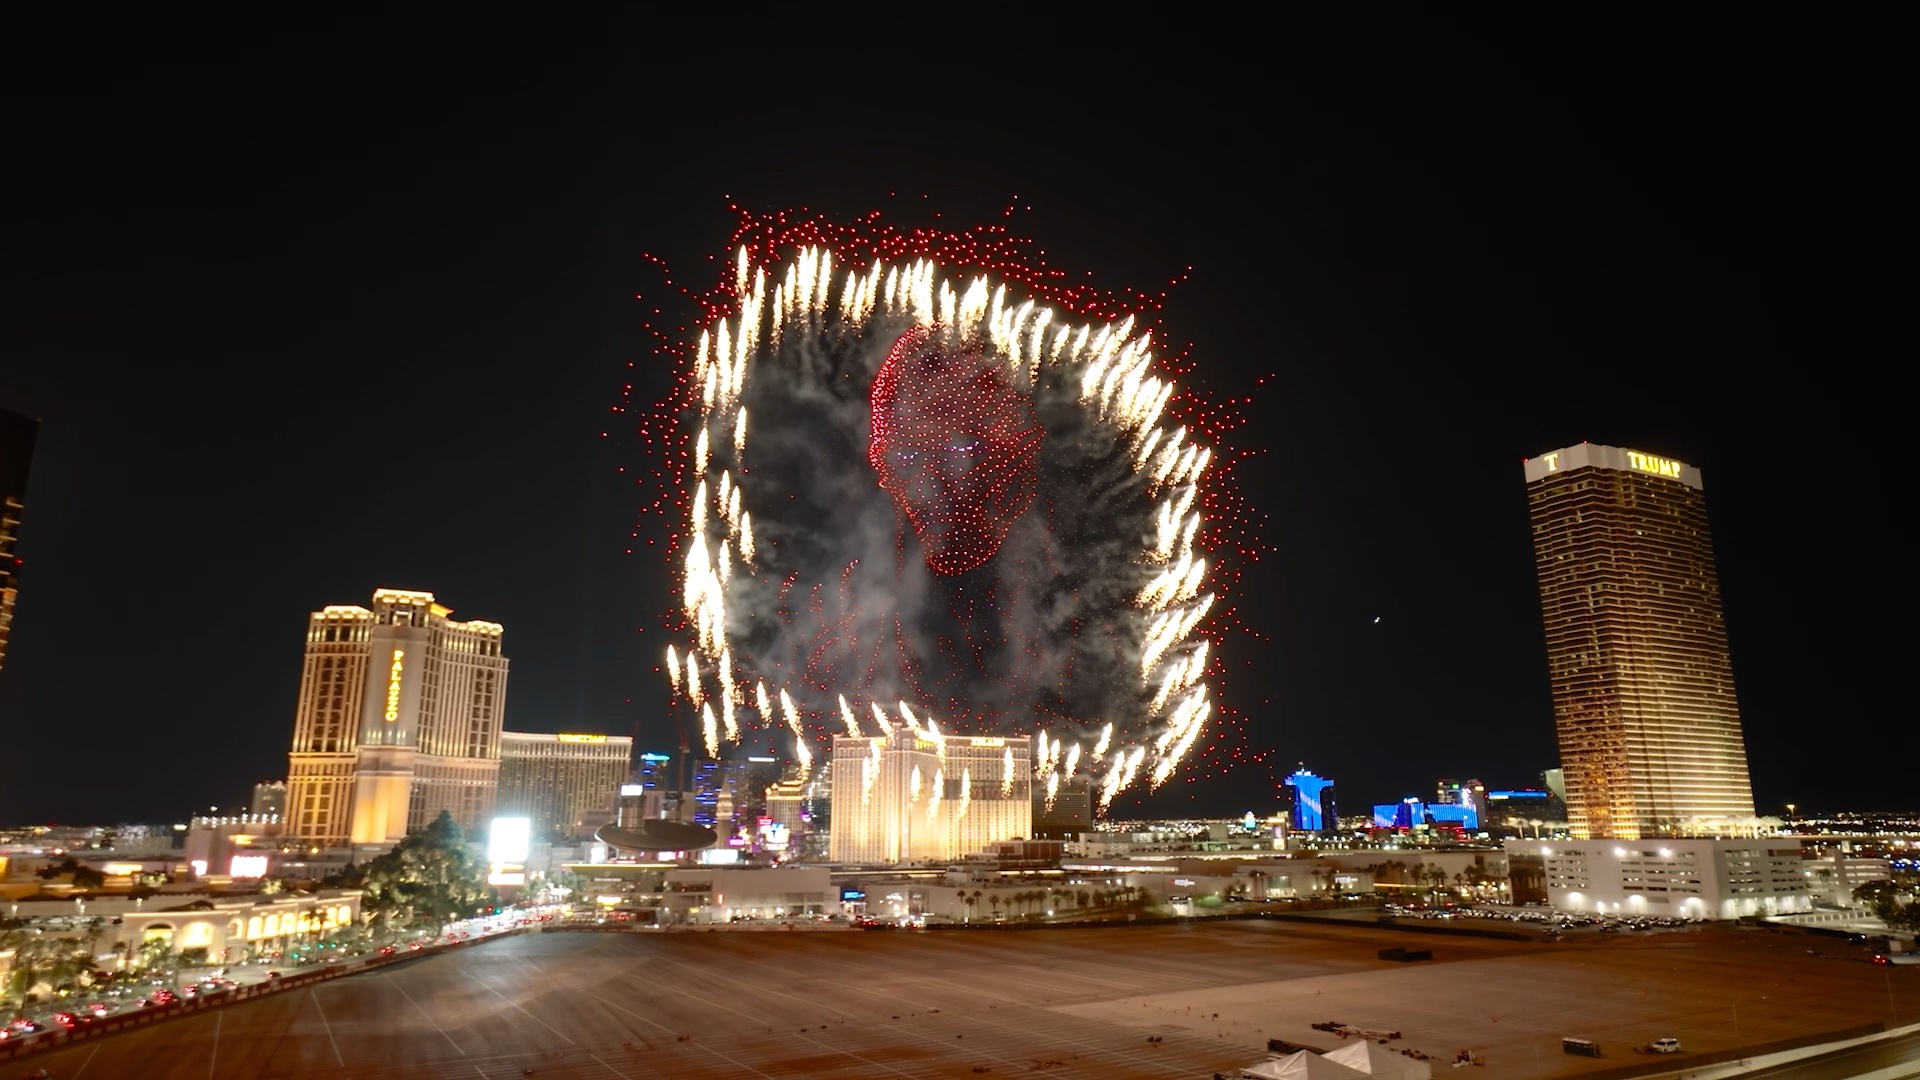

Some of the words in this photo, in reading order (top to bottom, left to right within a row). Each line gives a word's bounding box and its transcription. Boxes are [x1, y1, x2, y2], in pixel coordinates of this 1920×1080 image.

[1544, 453, 1559, 471] T
[1627, 451, 1681, 478] TRUMP
[385, 649, 404, 722] PALAZZO
